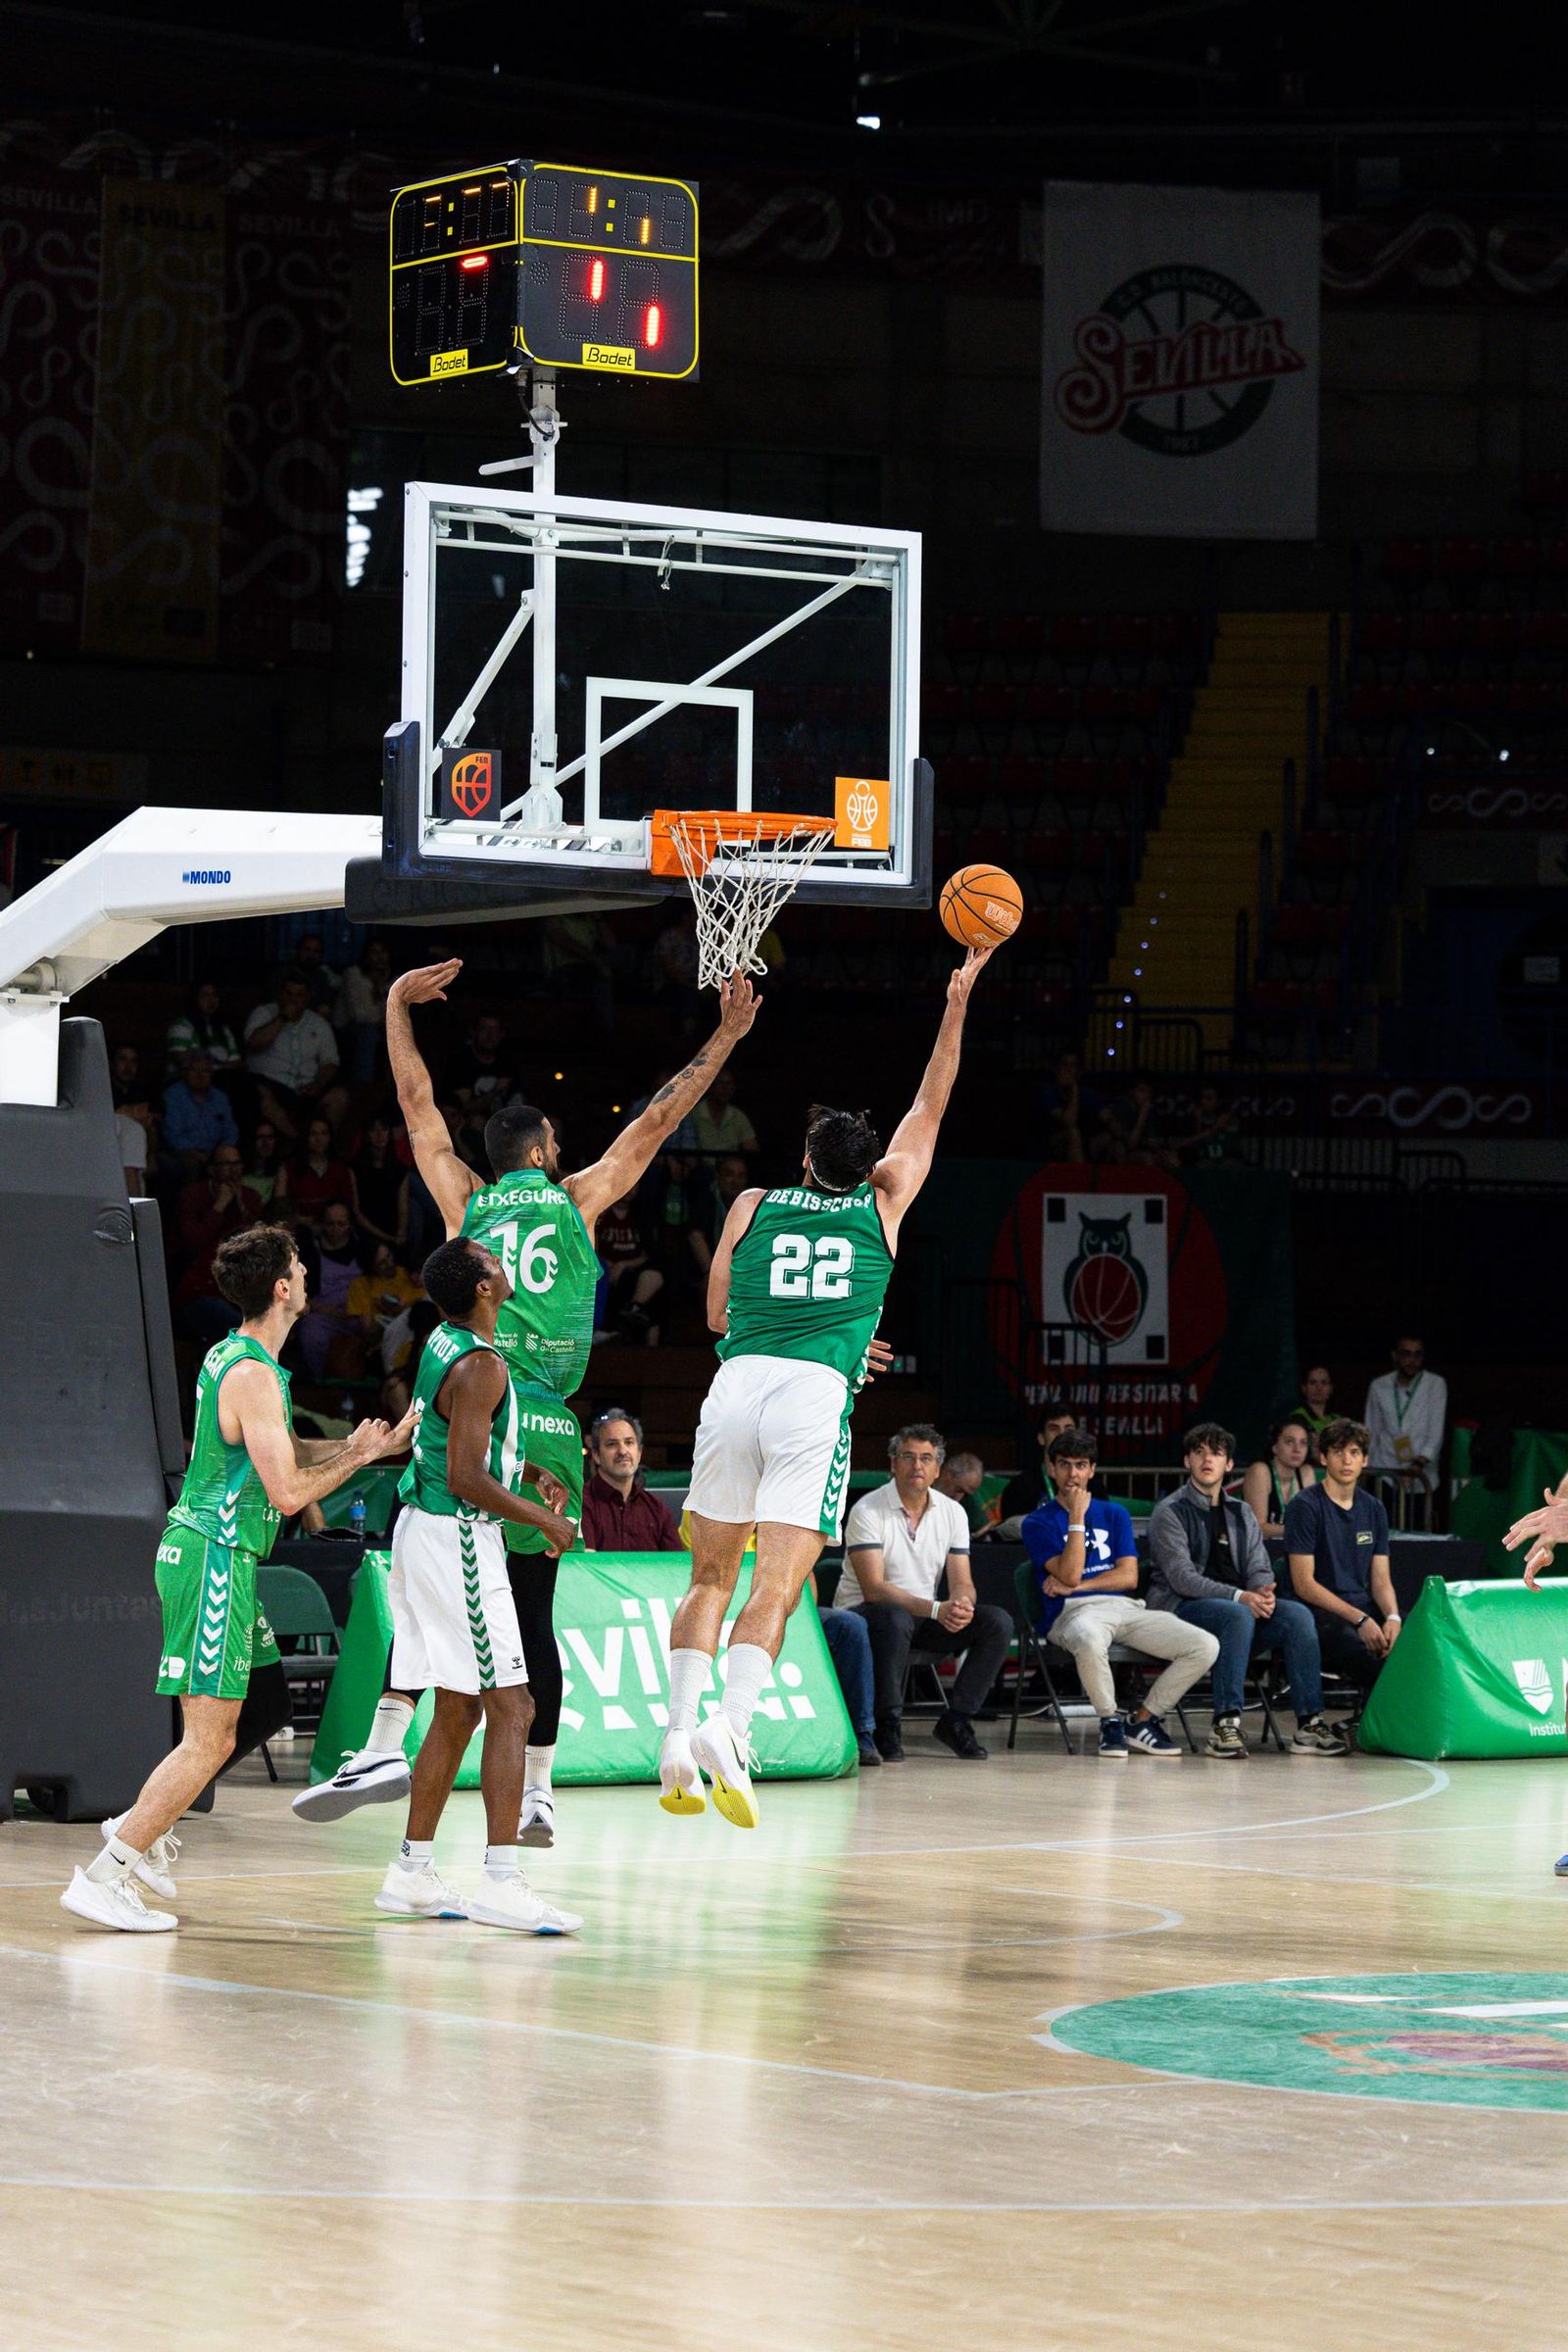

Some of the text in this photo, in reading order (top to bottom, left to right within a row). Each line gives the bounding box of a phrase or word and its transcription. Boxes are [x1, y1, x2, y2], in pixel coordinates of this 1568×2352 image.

[118, 204, 216, 233] SEVILLA
[432, 356, 466, 373] Bodet
[586, 348, 632, 367] Bodet
[190, 870, 231, 884] MONDO
[490, 1221, 559, 1294] 16
[769, 1234, 856, 1300] 22
